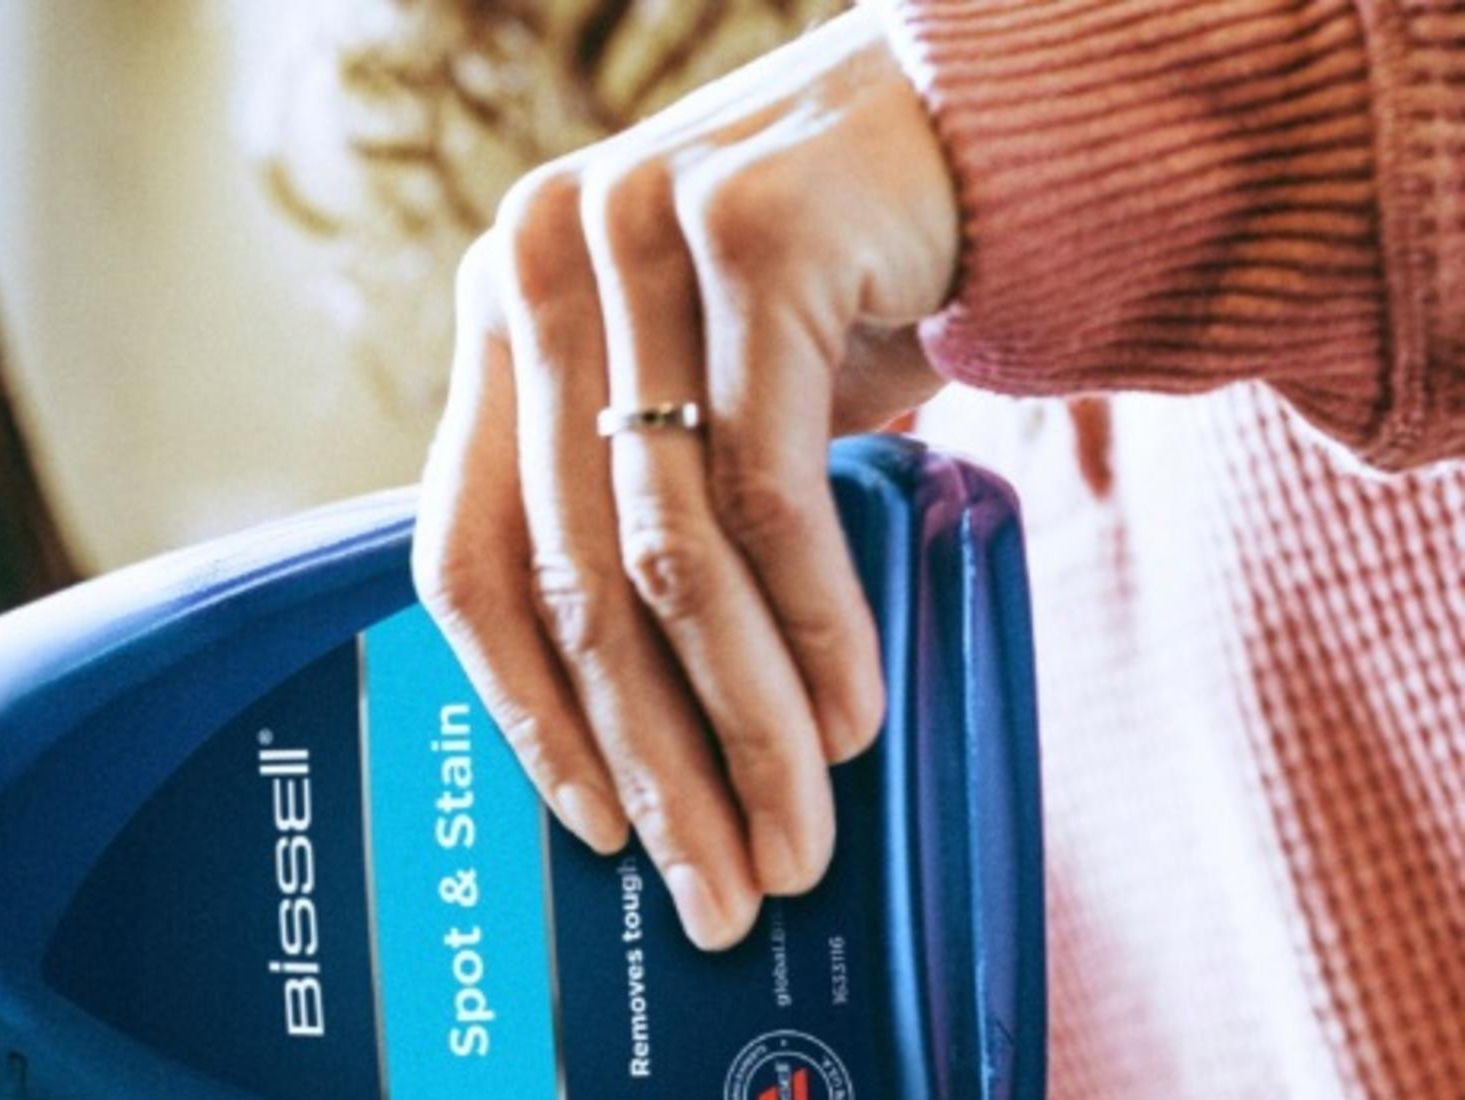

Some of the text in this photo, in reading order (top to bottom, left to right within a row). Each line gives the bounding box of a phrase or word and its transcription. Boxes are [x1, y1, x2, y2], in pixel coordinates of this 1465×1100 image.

[430, 703, 495, 1057] Spot & Stain
[626, 948, 650, 1078] Removes
